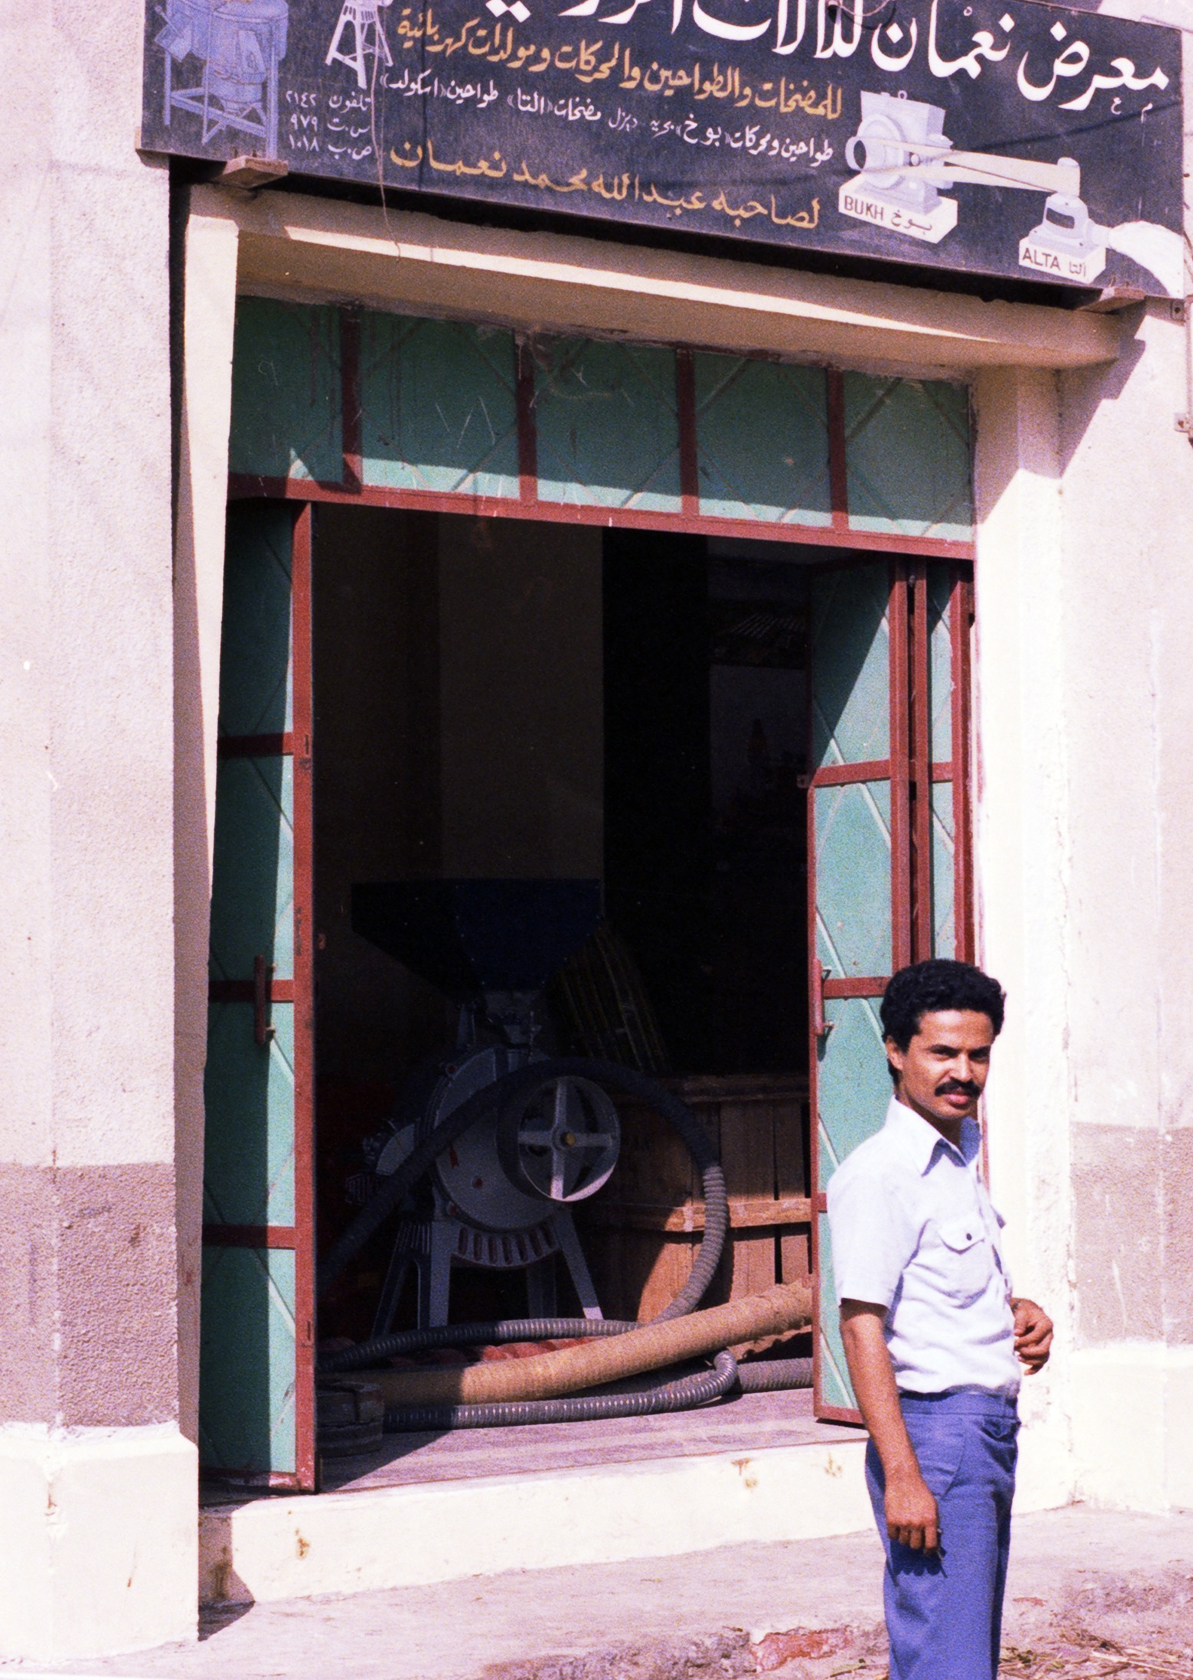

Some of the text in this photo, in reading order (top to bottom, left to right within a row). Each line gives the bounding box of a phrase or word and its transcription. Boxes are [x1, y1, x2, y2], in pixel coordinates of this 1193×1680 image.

[397, 8, 480, 57] كهربائية
[871, 0, 1015, 79] نعمان
[554, 38, 641, 89] والمحركات
[1017, 21, 1169, 110] معرض
[447, 79, 499, 108] طواحين
[643, 61, 752, 107] والطواحين
[754, 76, 842, 120] للمضخات
[285, 90, 371, 114] تلفون ٢١٤٢
[554, 96, 602, 121] مضخات
[290, 113, 318, 132] ٩٧٩
[608, 107, 638, 132] ديزل
[289, 134, 320, 152] ١٠١٨
[781, 137, 834, 167] طواحين
[390, 139, 507, 178] نعمان
[512, 160, 588, 193] محمد
[844, 195, 884, 221] BUKH
[890, 209, 933, 236] بوخ
[1022, 247, 1061, 271] ALTA
